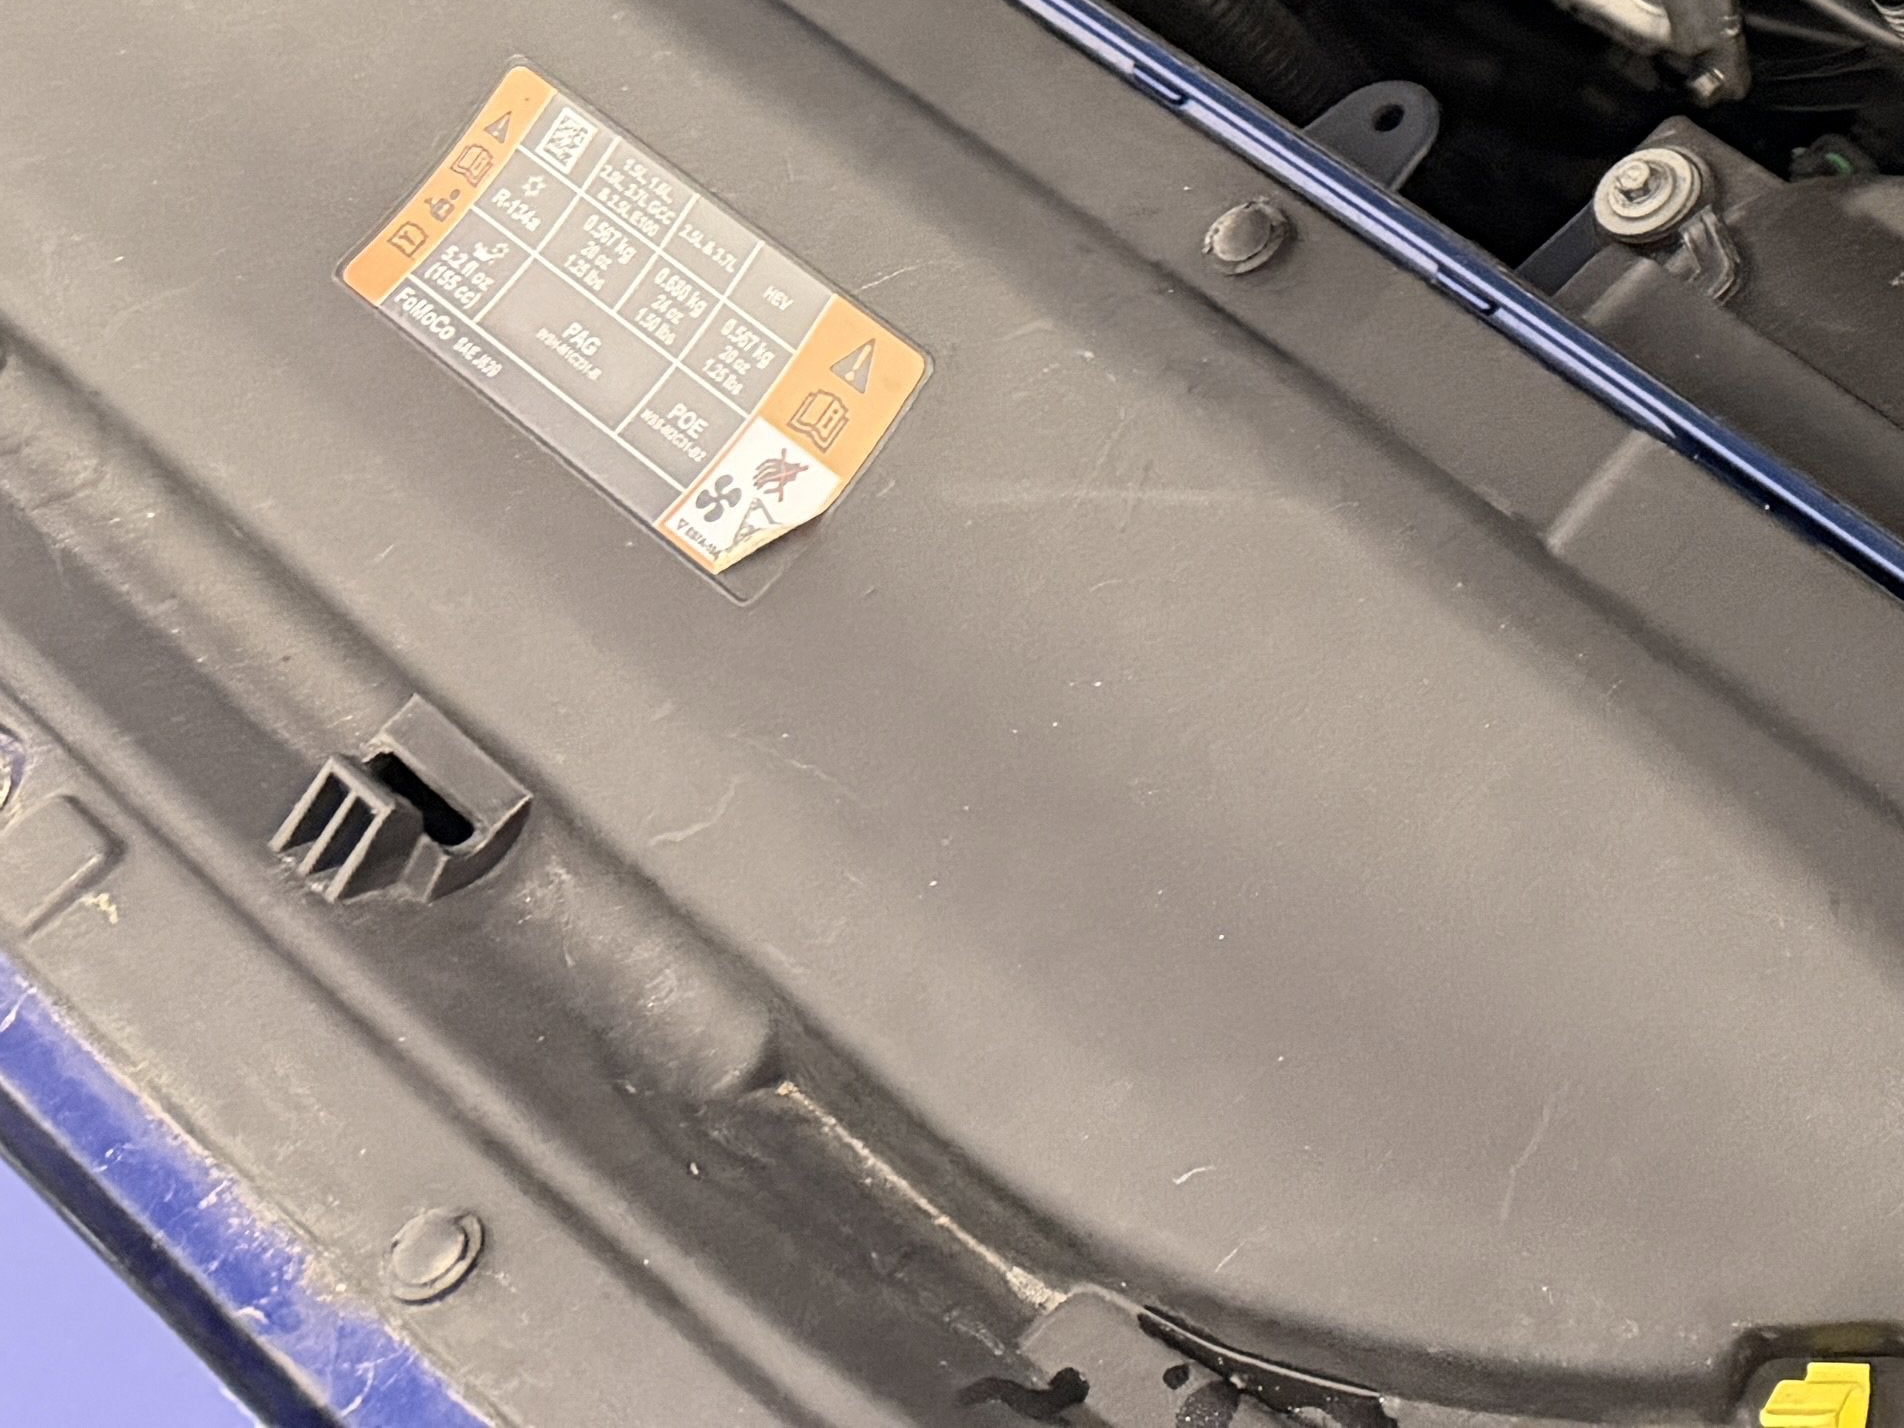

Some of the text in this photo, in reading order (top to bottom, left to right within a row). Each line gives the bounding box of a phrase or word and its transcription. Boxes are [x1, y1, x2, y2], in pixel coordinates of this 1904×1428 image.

[492, 188, 542, 231] R-134a
[647, 202, 673, 224] GCC
[581, 241, 610, 270] 20 oz
[582, 215, 636, 265] 0.567 kg
[425, 261, 479, 310] (155 cc)
[441, 245, 467, 269] 5.2
[472, 271, 491, 290] oz
[654, 268, 708, 318] 0.680 kg
[764, 286, 791, 310] HEV
[393, 287, 457, 341] FoMoCo
[665, 308, 681, 324] oz
[562, 322, 601, 356] PAG
[655, 323, 677, 345] lbs
[721, 318, 774, 369] 0.567 kg
[702, 357, 744, 395] 1.25 lbs
[719, 345, 749, 374] 20 oz
[668, 403, 706, 438] POE
